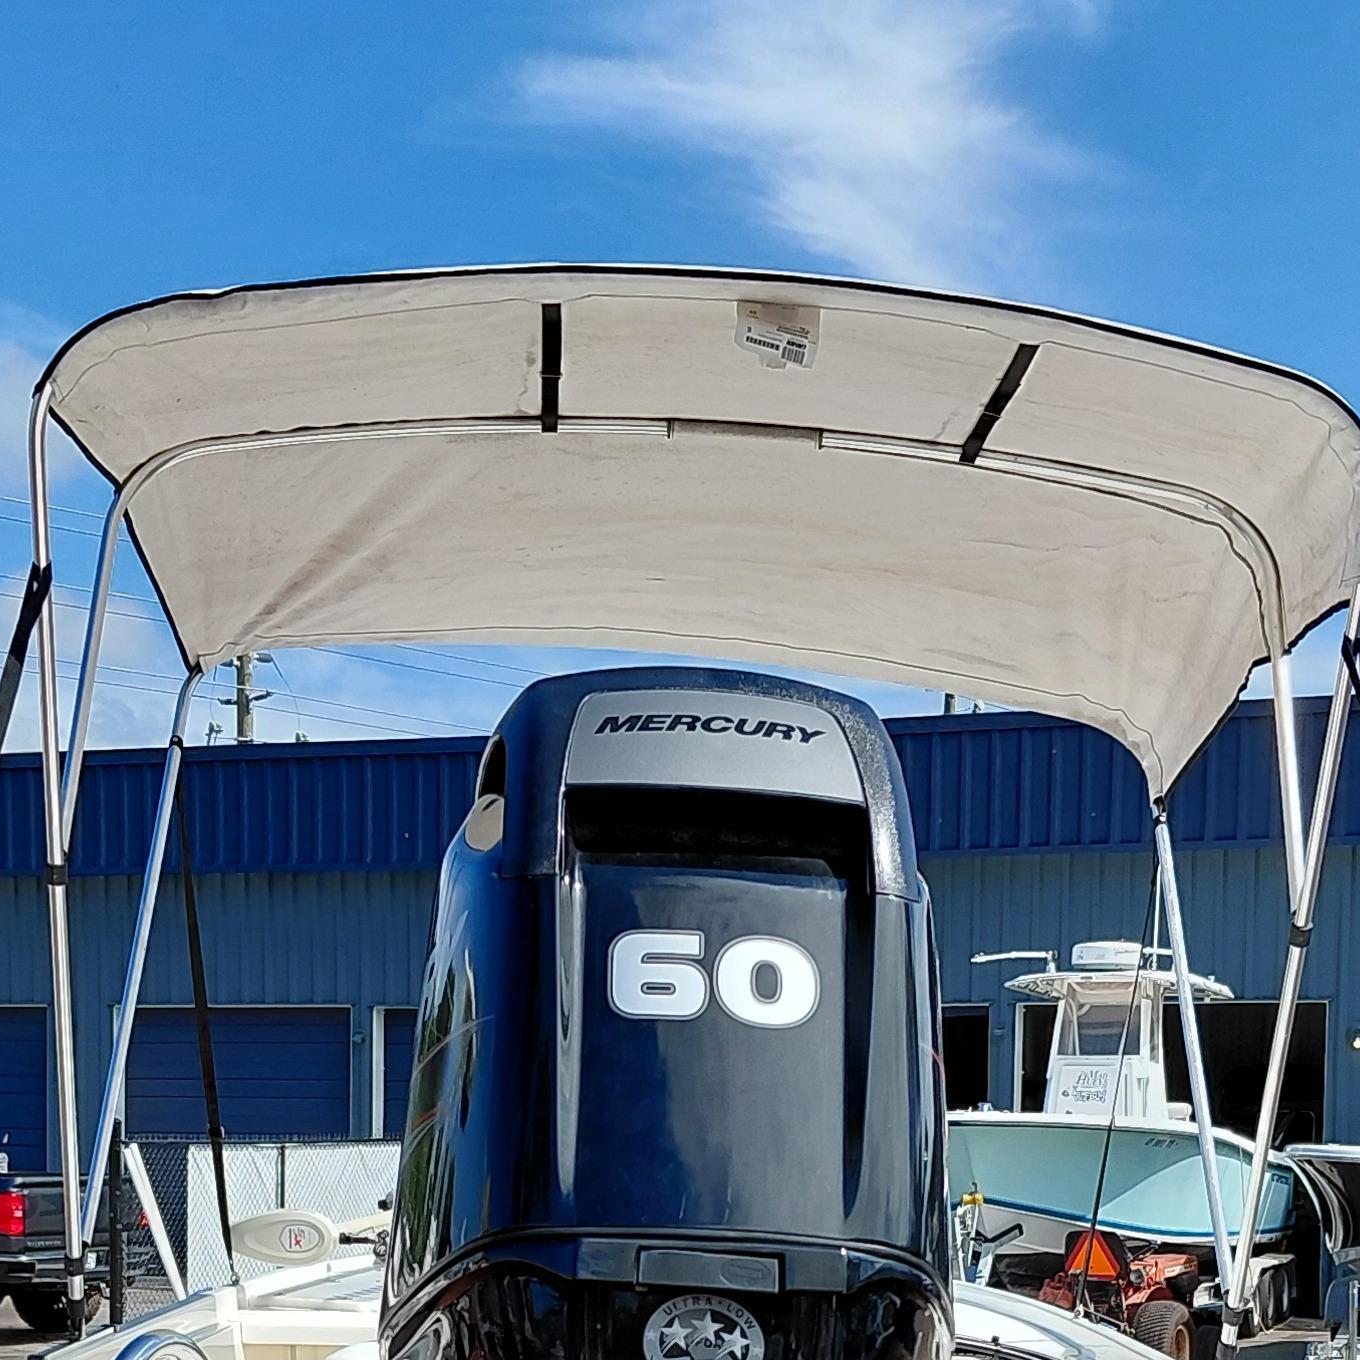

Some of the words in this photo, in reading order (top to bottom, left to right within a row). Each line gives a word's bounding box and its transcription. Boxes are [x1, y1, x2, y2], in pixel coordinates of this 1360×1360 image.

[595, 713, 827, 744] MERCURY
[607, 928, 822, 1028] 60
[662, 1295, 714, 1317] ULTRA
[726, 1302, 757, 1331] LOW
